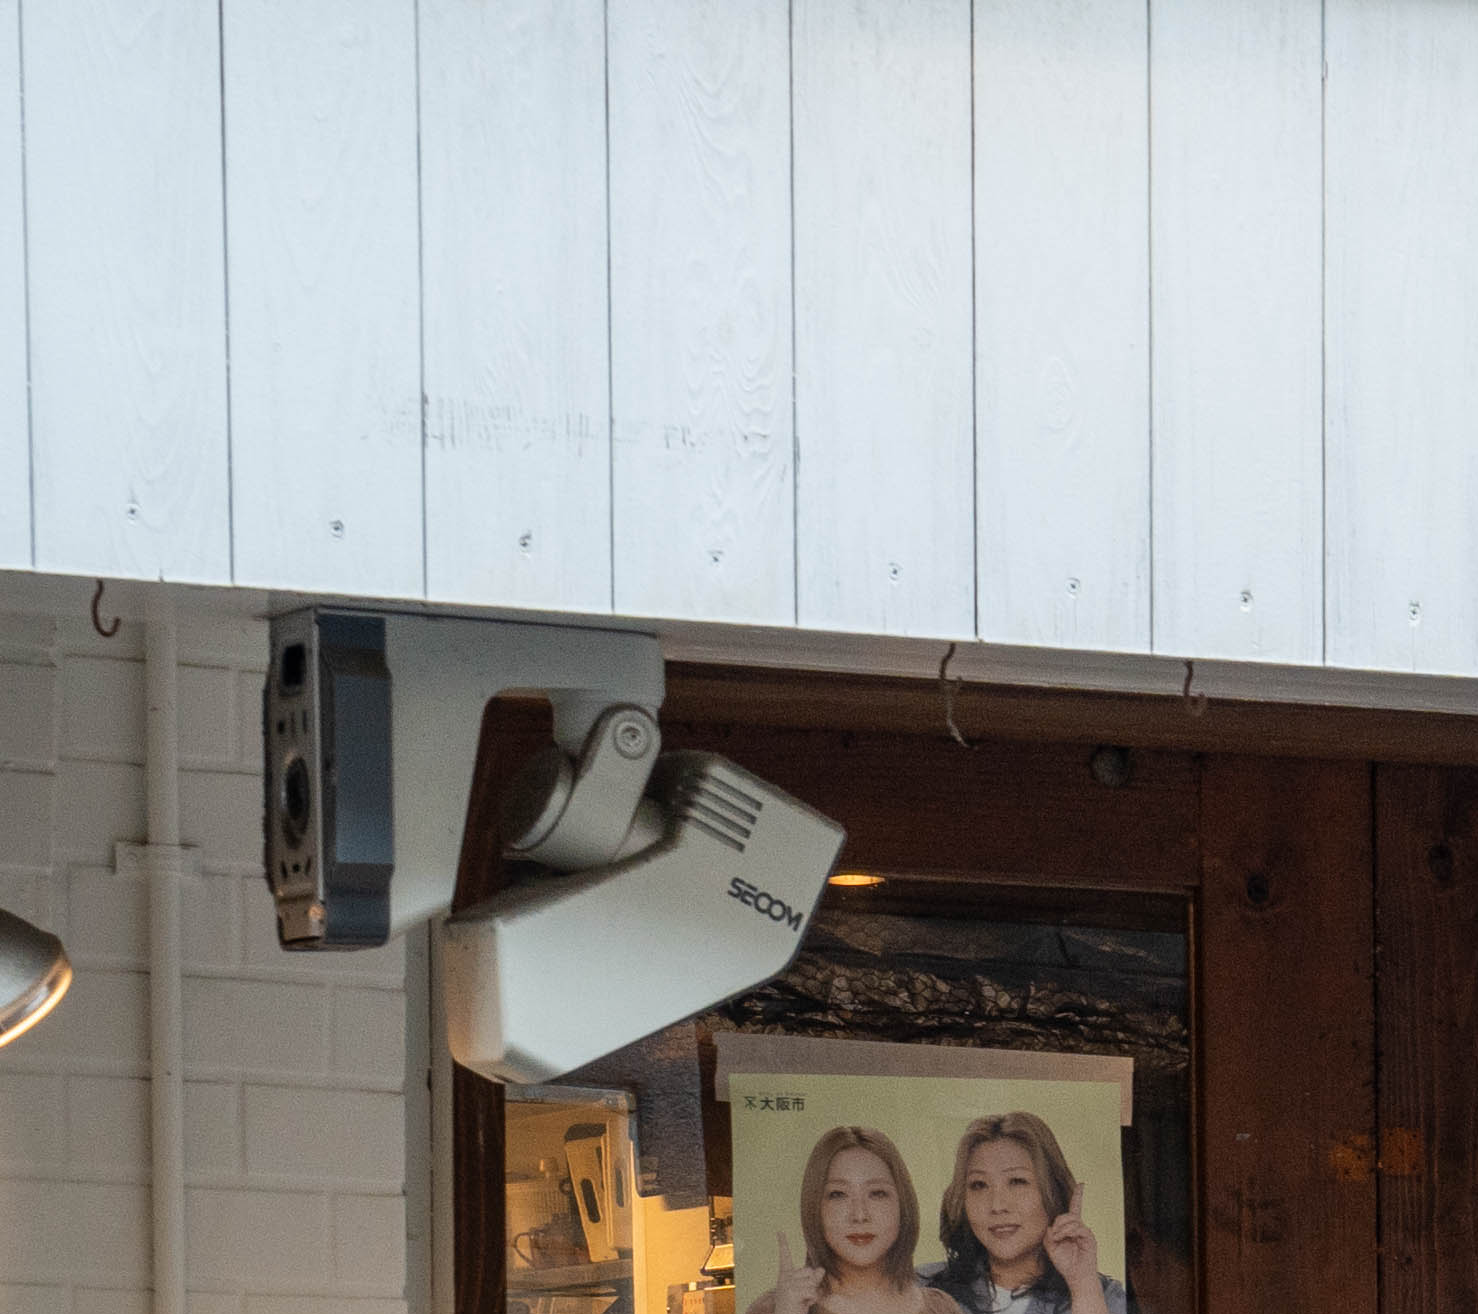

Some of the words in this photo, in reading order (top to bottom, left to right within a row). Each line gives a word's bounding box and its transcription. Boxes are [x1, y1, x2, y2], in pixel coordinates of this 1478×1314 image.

[727, 877, 803, 933] SECOM
[760, 1096, 805, 1112] 大阪市
